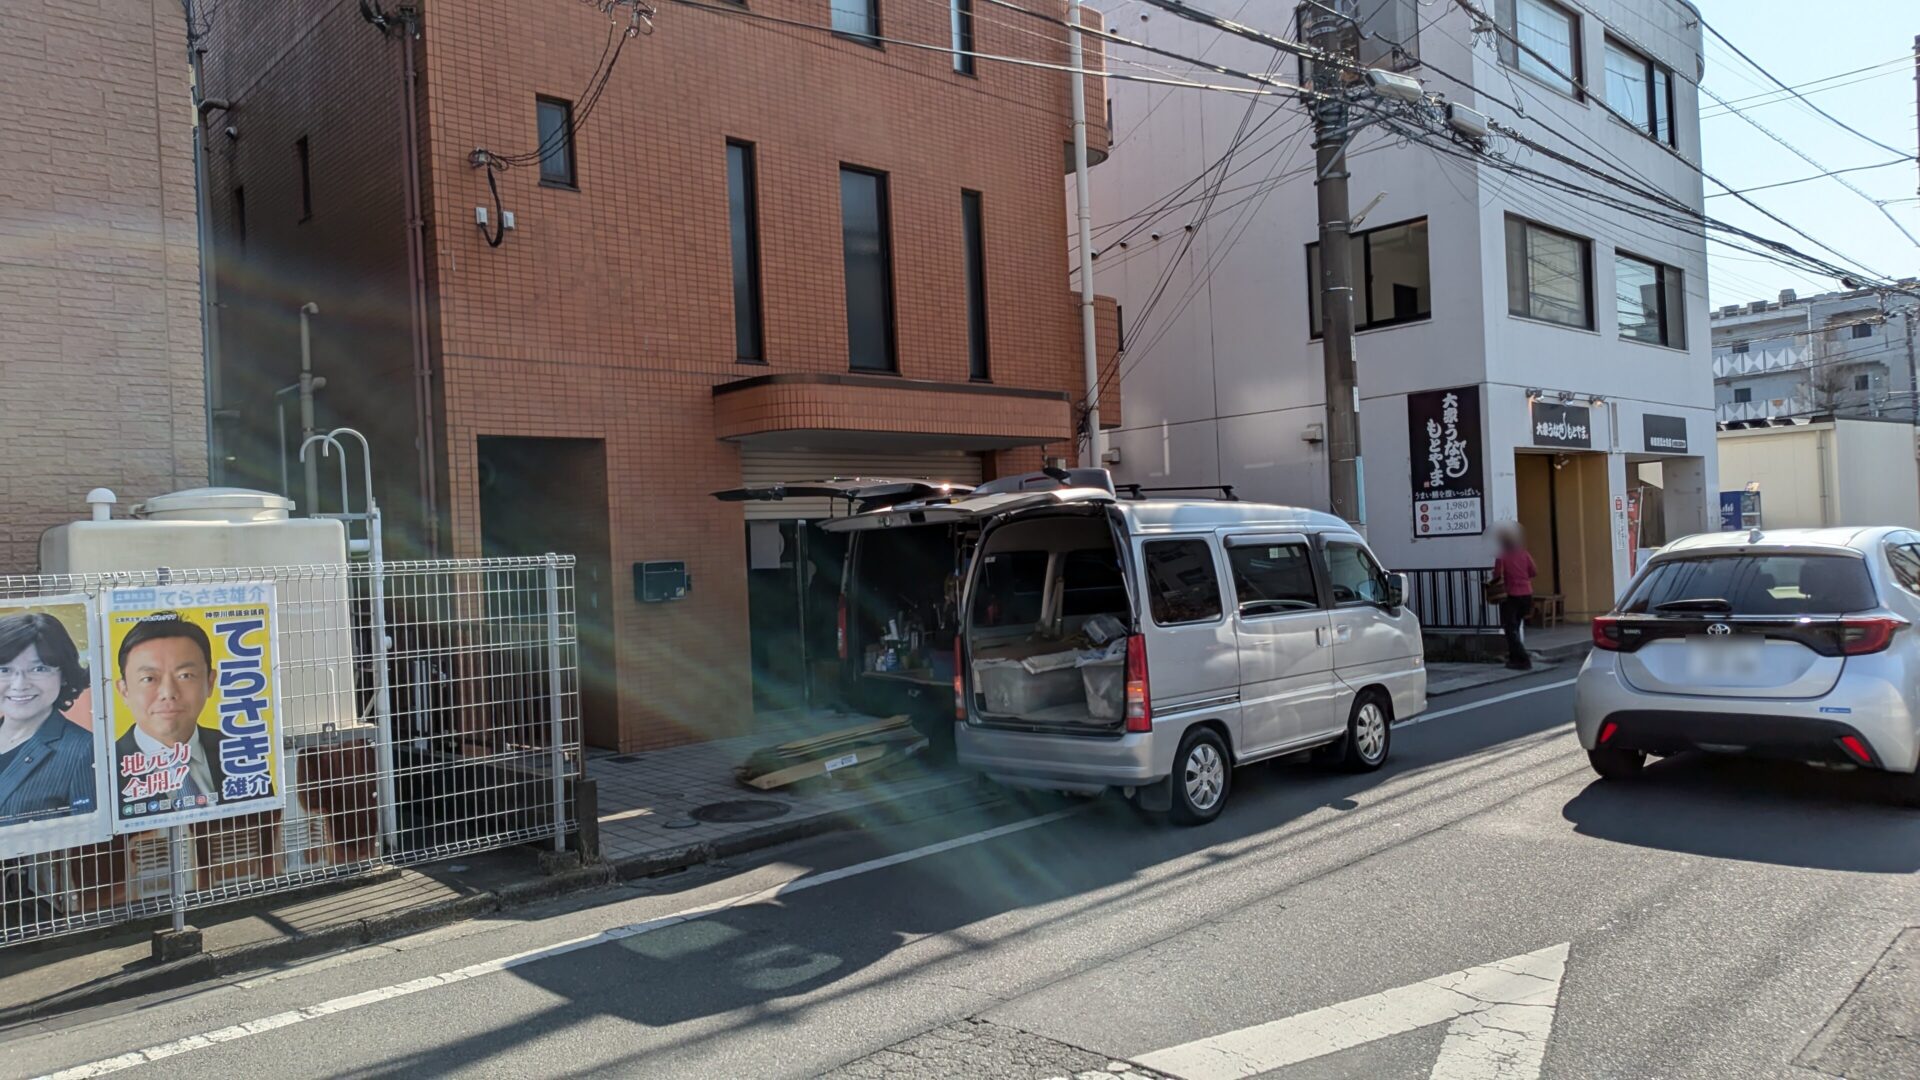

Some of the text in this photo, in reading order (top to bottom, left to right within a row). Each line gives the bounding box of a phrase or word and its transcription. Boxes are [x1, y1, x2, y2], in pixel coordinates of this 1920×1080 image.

[1427, 418, 1444, 487] もとやま
[1442, 393, 1468, 478] 大衆うなぎ
[160, 586, 265, 606] てらさき雄介
[205, 609, 264, 619] 神奈川県議会議員
[214, 619, 270, 776] てらさき
[122, 742, 190, 776] 地元力
[223, 774, 271, 800] 雄介
